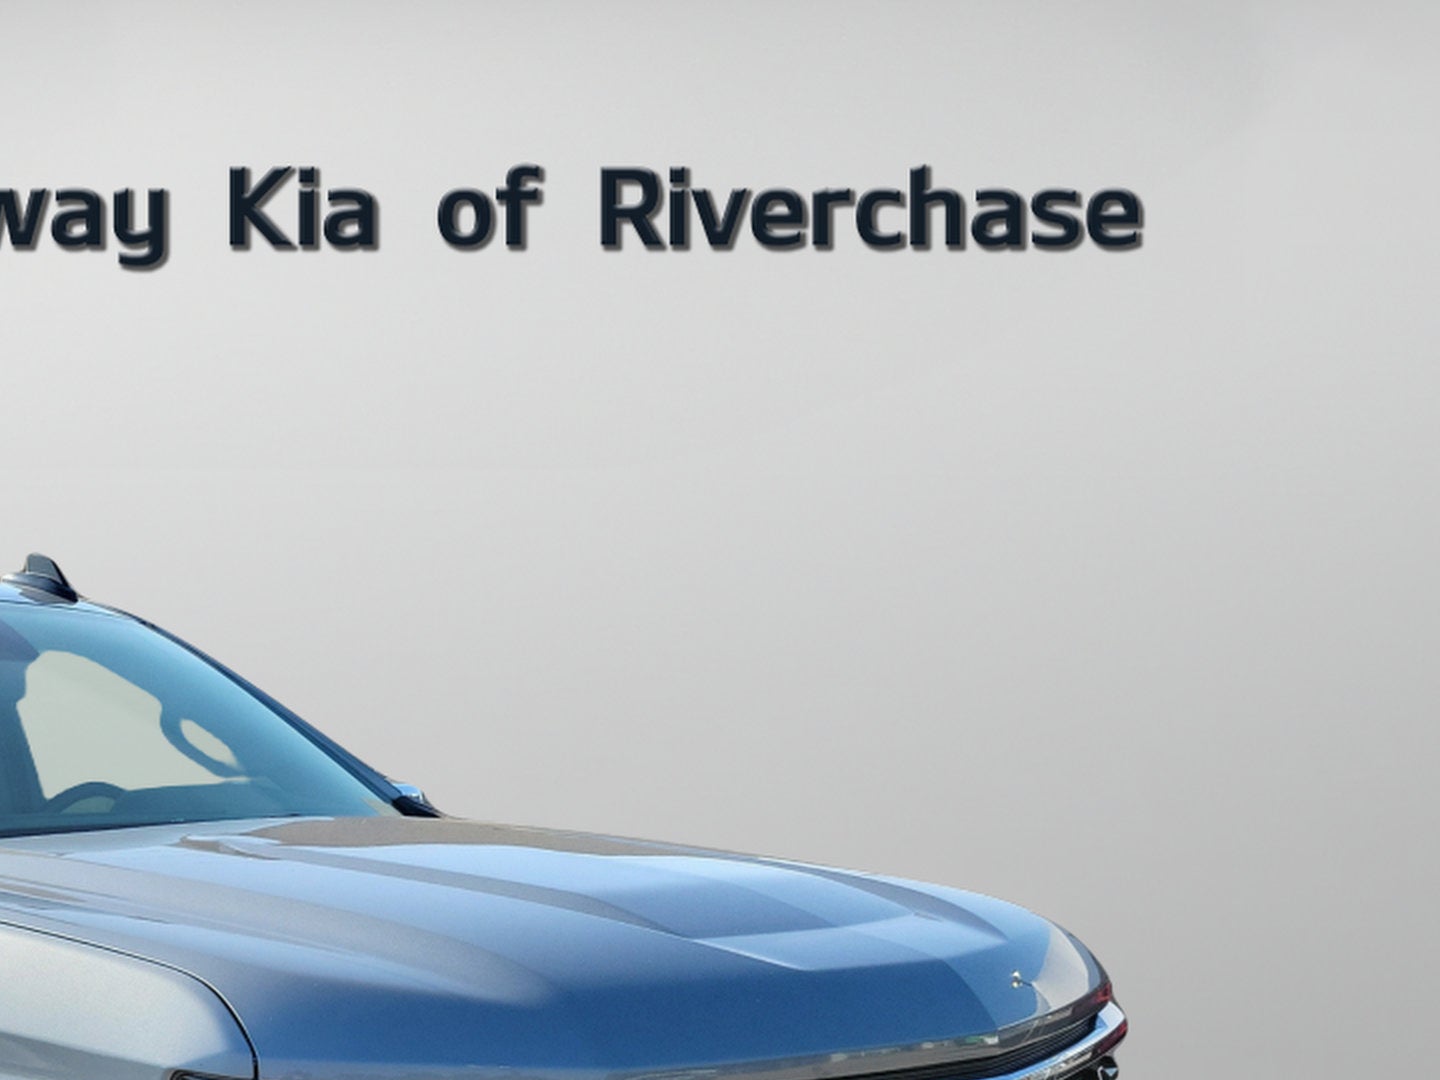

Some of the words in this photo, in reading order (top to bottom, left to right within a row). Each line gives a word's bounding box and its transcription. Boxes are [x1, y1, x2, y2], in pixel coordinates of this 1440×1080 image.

[230, 165, 378, 251] Kia
[438, 165, 544, 251] of
[601, 164, 1143, 251] Riverchase
